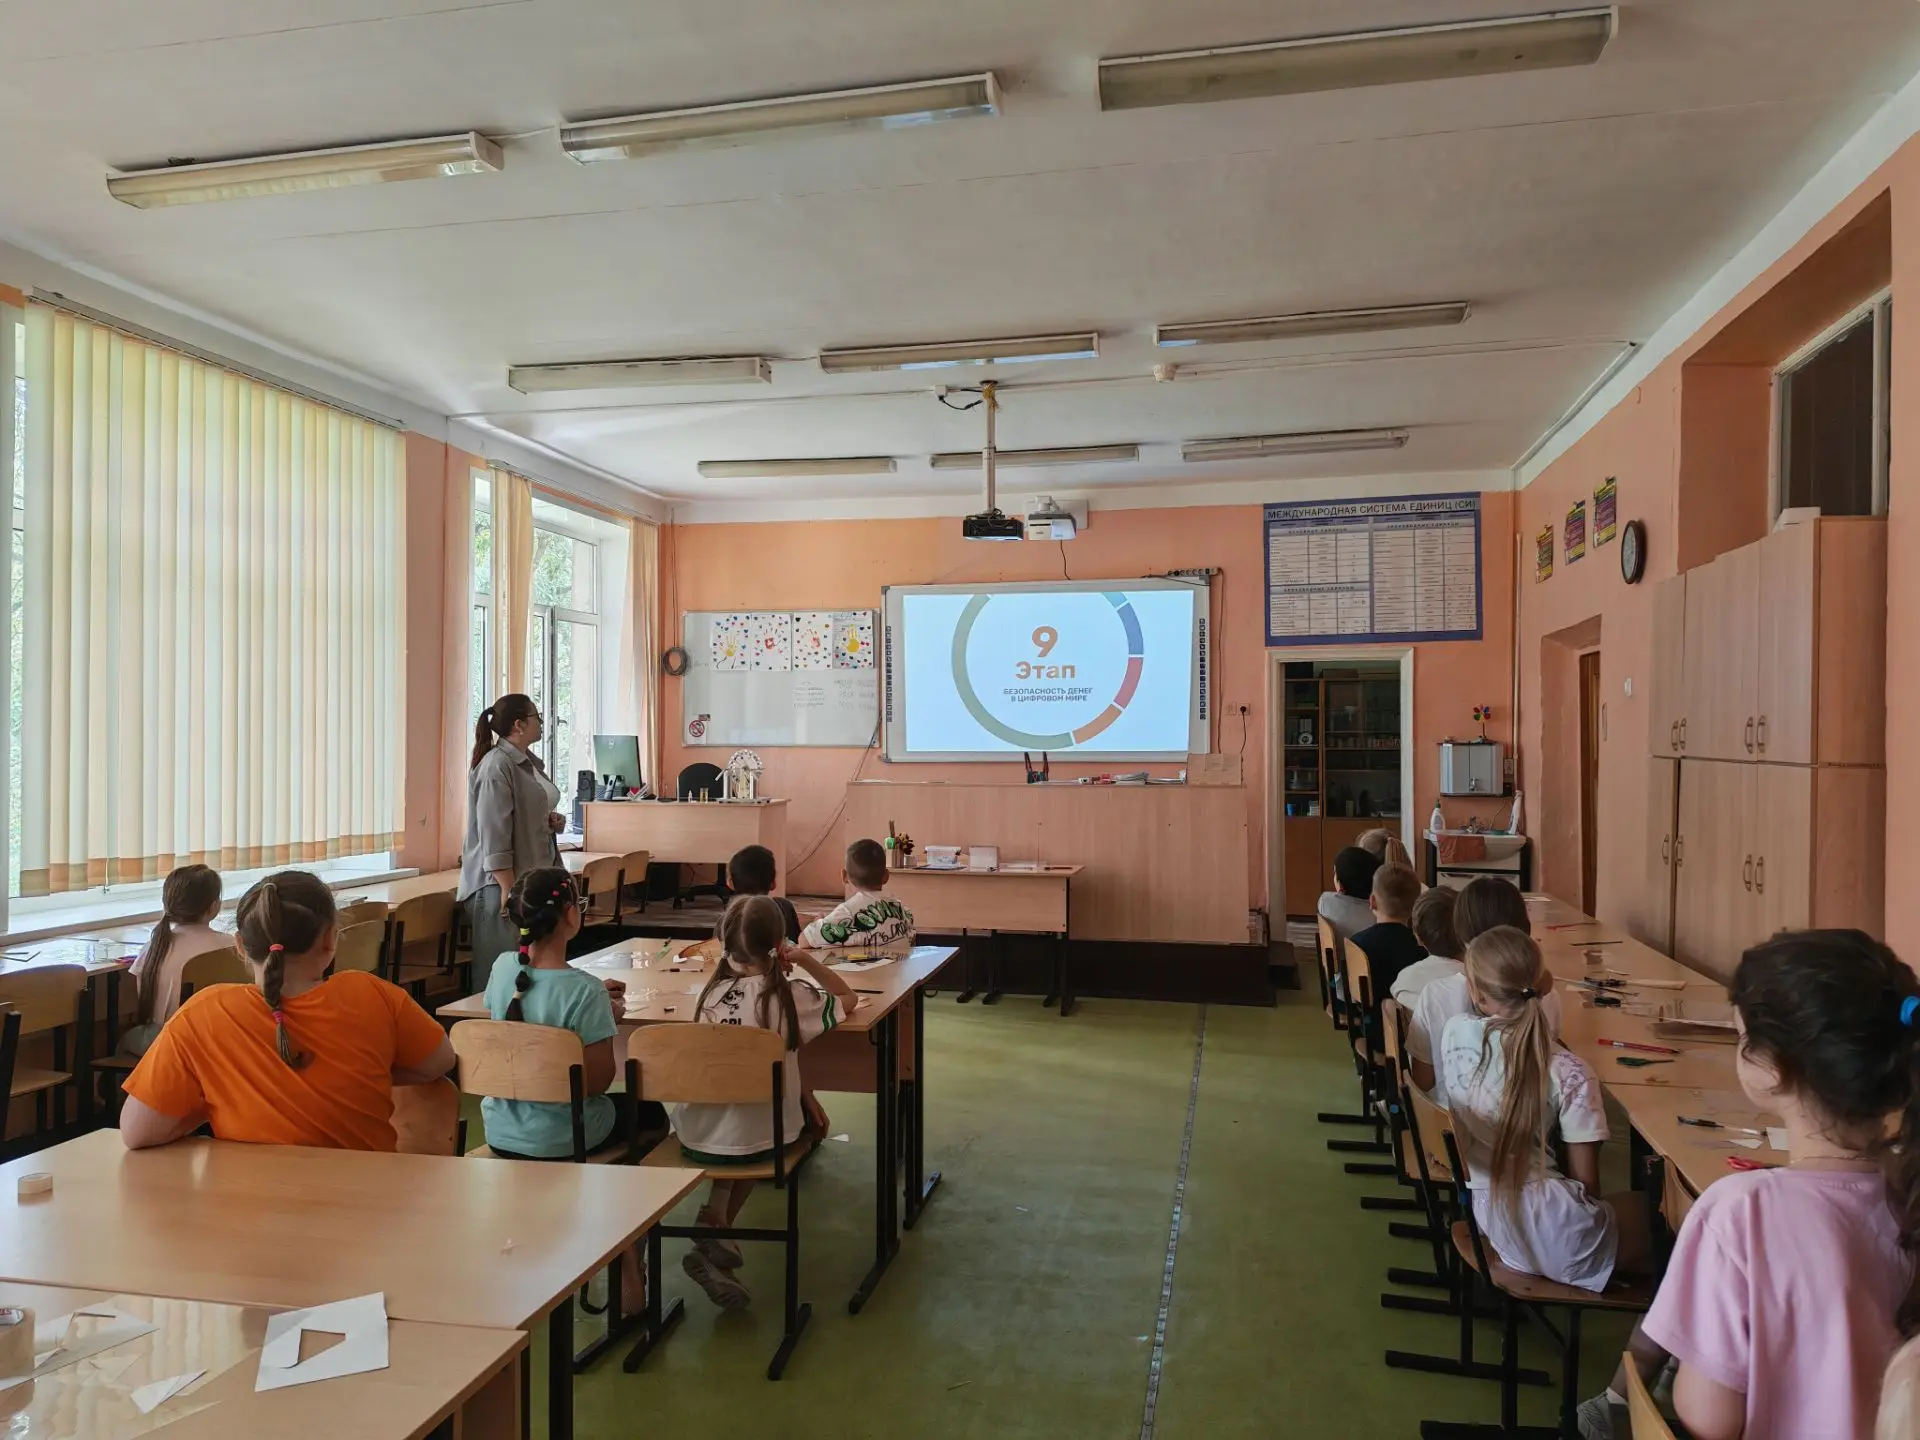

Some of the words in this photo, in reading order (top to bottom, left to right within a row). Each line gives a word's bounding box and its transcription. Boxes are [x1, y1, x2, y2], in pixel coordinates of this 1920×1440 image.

[1268, 506, 1356, 519] МЕЖДУНАРОДНАЯ
[1360, 503, 1407, 514] СИСТЕМА
[1410, 500, 1452, 511] ЕДИНИЦ
[1031, 625, 1058, 658] 9
[1015, 661, 1076, 680] Этап
[1067, 687, 1094, 695] ДЕНЕГ
